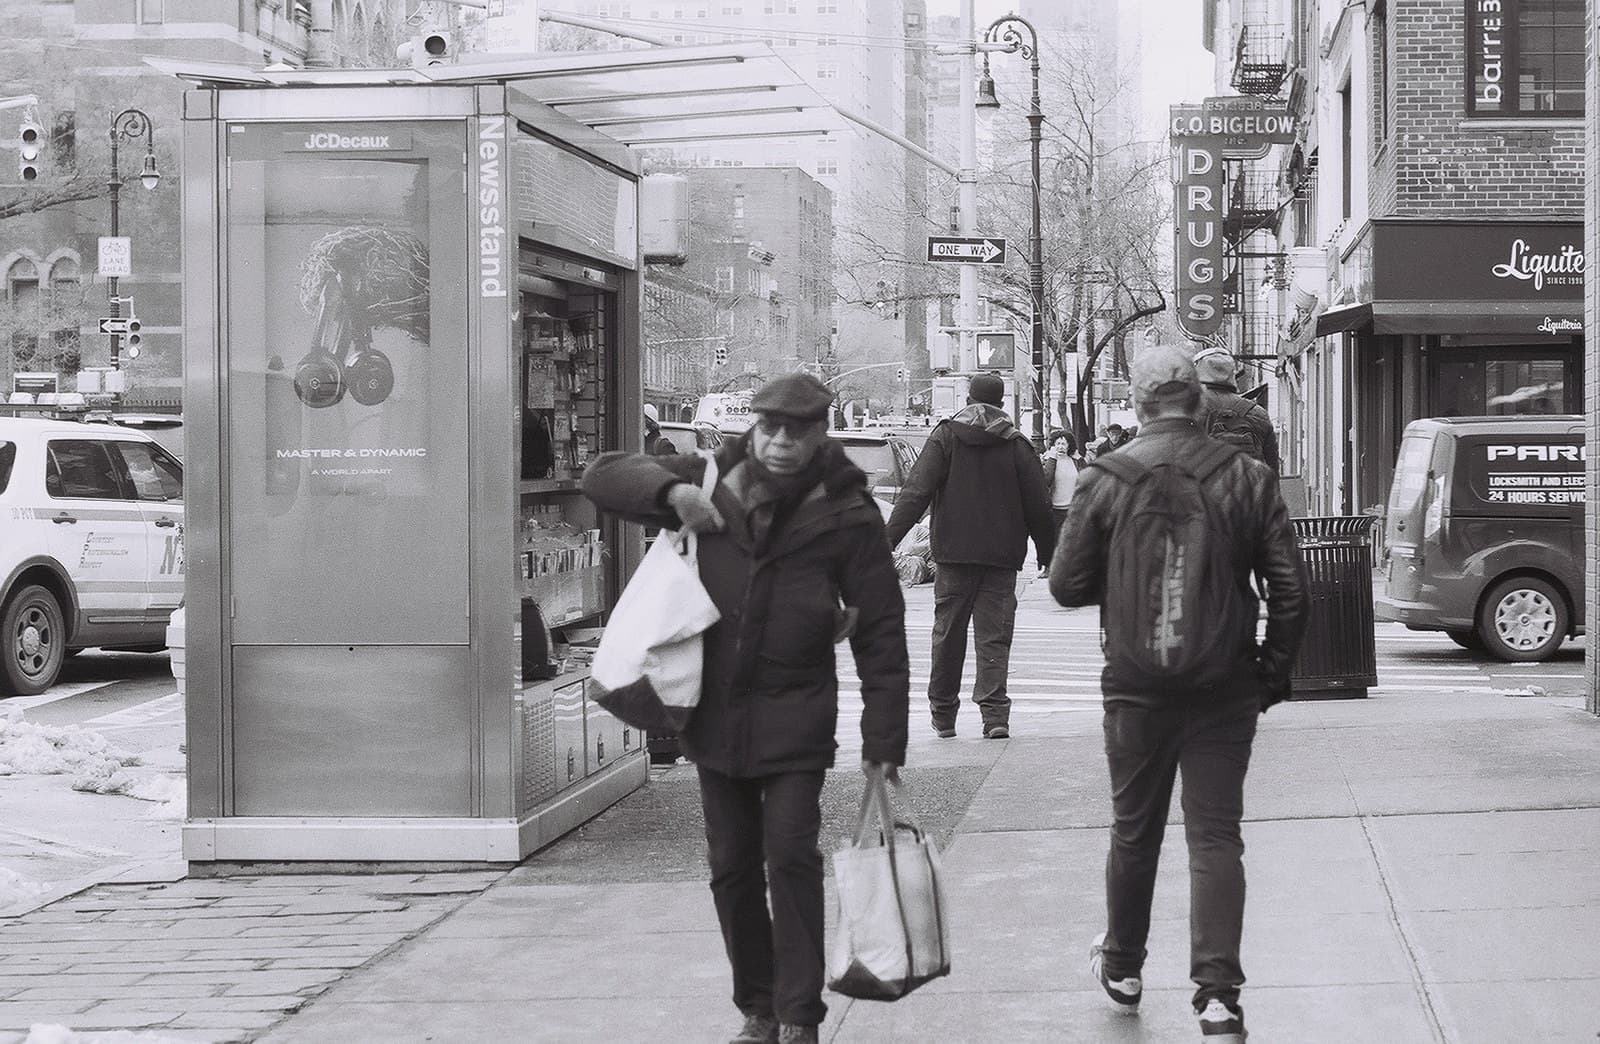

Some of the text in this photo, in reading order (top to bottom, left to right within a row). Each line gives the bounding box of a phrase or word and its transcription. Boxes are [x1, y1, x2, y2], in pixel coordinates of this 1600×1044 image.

[1210, 116, 1295, 134] BIGELOW
[305, 134, 391, 149] JCDecaux
[479, 116, 507, 297] Newsstand
[1187, 149, 1216, 321] DRUGS
[938, 244, 994, 256] ONE WAY
[1492, 239, 1585, 290] Liquite
[1547, 277, 1566, 285] SINCE
[1537, 317, 1583, 335] Liquiteria
[276, 448, 427, 458] MASTER & DYNAMIC
[1487, 445, 1585, 461] PAR
[1489, 477, 1541, 486] LOCKSMITH
[1542, 477, 1561, 486] AND
[1488, 491, 1505, 501] 24
[1507, 492, 1546, 503] HOURS
